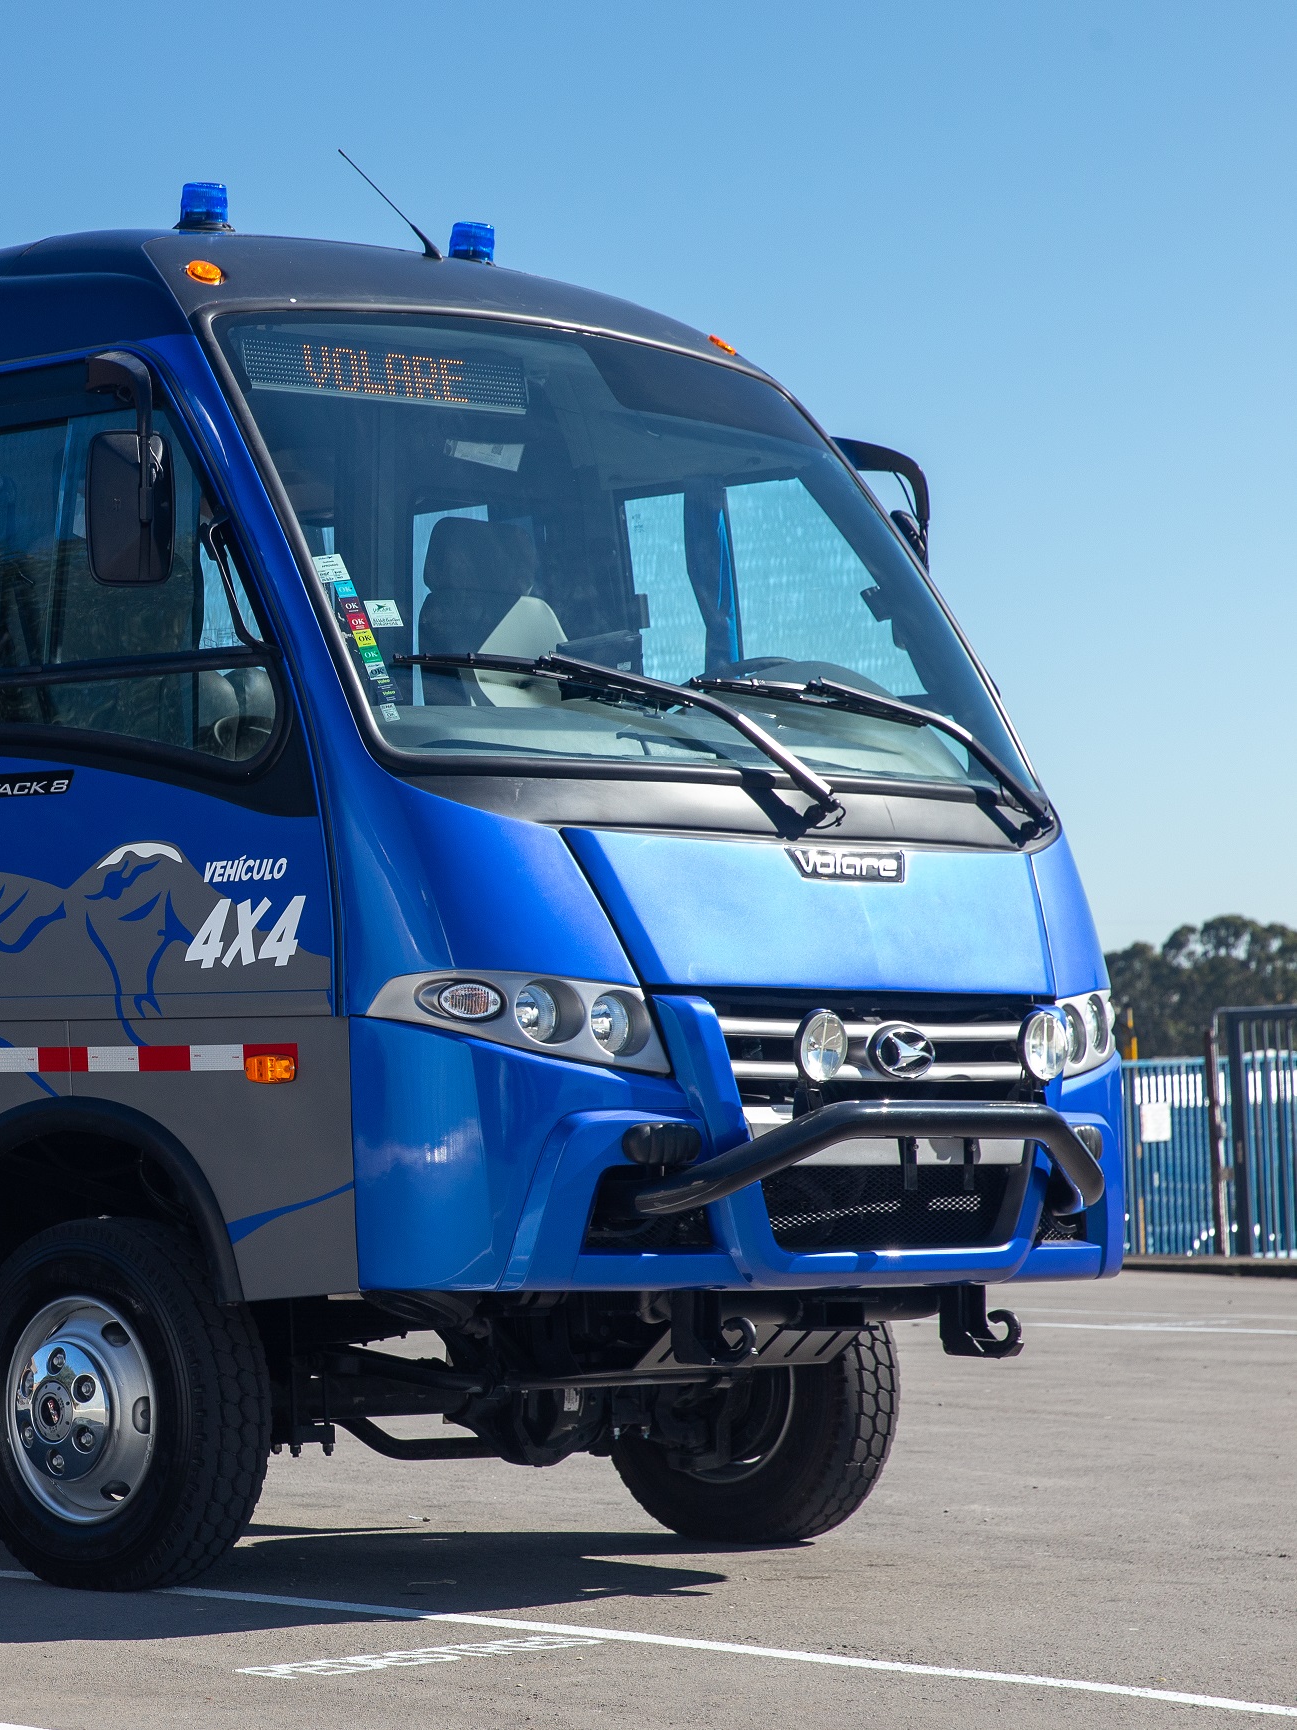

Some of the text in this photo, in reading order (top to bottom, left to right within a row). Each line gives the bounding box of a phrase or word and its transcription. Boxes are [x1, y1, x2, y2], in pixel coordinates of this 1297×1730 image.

[303, 344, 468, 402] VOLARE
[345, 602, 359, 610] OK
[351, 618, 365, 626] OK
[370, 667, 384, 675] OK
[50, 780, 69, 793] 8
[203, 854, 288, 883] VEHÍCULO
[794, 850, 898, 877] Volare
[184, 895, 307, 969] 4X4
[233, 1635, 604, 1680] PEDESTRES
